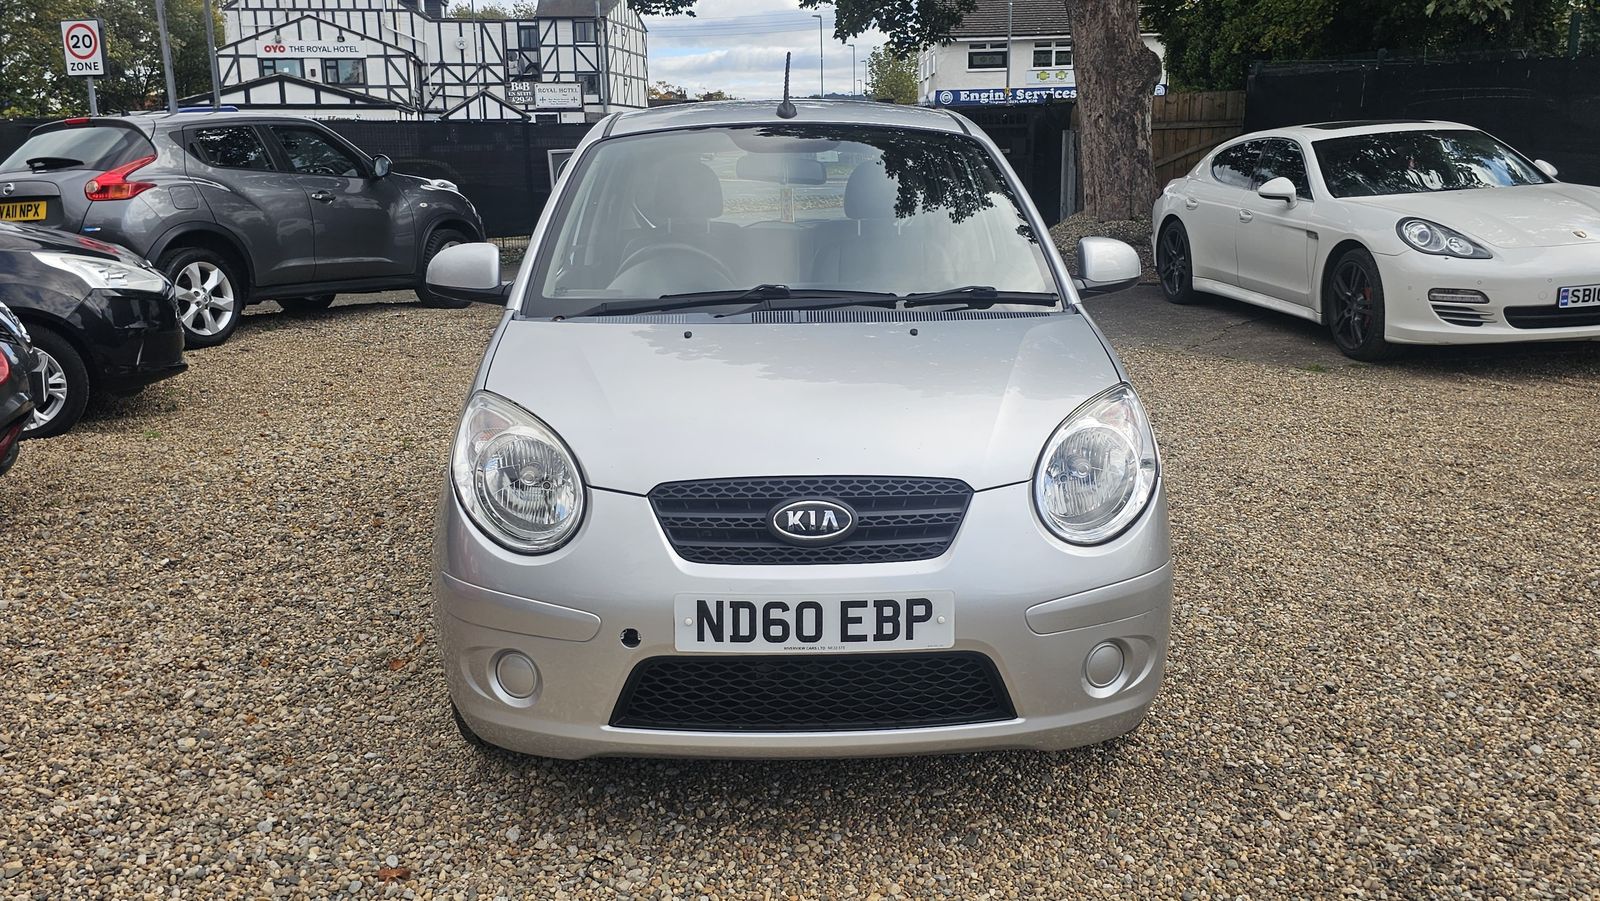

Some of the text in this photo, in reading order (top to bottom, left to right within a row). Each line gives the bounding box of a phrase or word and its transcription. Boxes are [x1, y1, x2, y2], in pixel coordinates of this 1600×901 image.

[71, 34, 92, 48] 20
[264, 45, 286, 53] OYO
[70, 62, 99, 71] ZONE
[511, 82, 530, 91] B&B
[960, 88, 1077, 104] Engine Services
[20, 203, 40, 218] NPX
[786, 510, 840, 531] KIA
[696, 598, 933, 643] ND60 EBP
